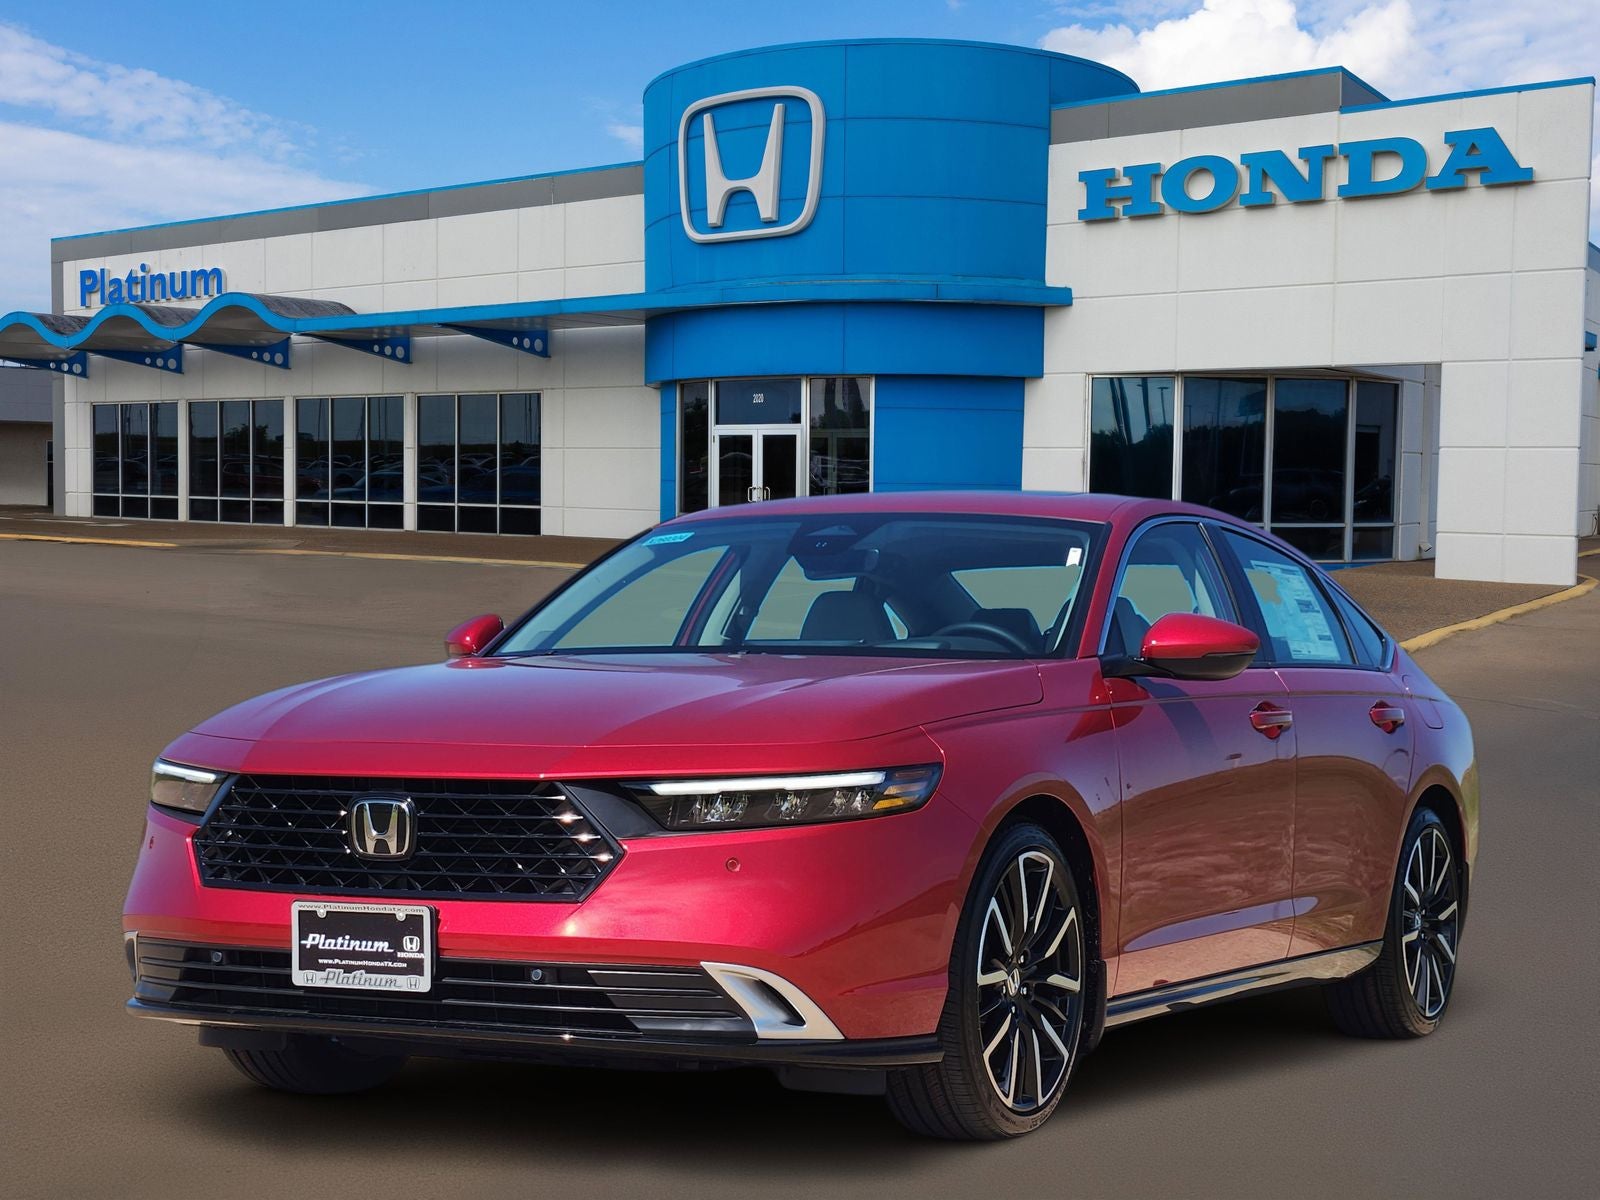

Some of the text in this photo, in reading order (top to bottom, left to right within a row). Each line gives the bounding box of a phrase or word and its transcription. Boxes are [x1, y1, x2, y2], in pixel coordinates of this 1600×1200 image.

[1079, 127, 1534, 222] HONDA
[79, 263, 223, 306] Platinum
[752, 393, 764, 403] 2020
[300, 933, 395, 953] Platinum
[319, 970, 403, 988] Platinum
